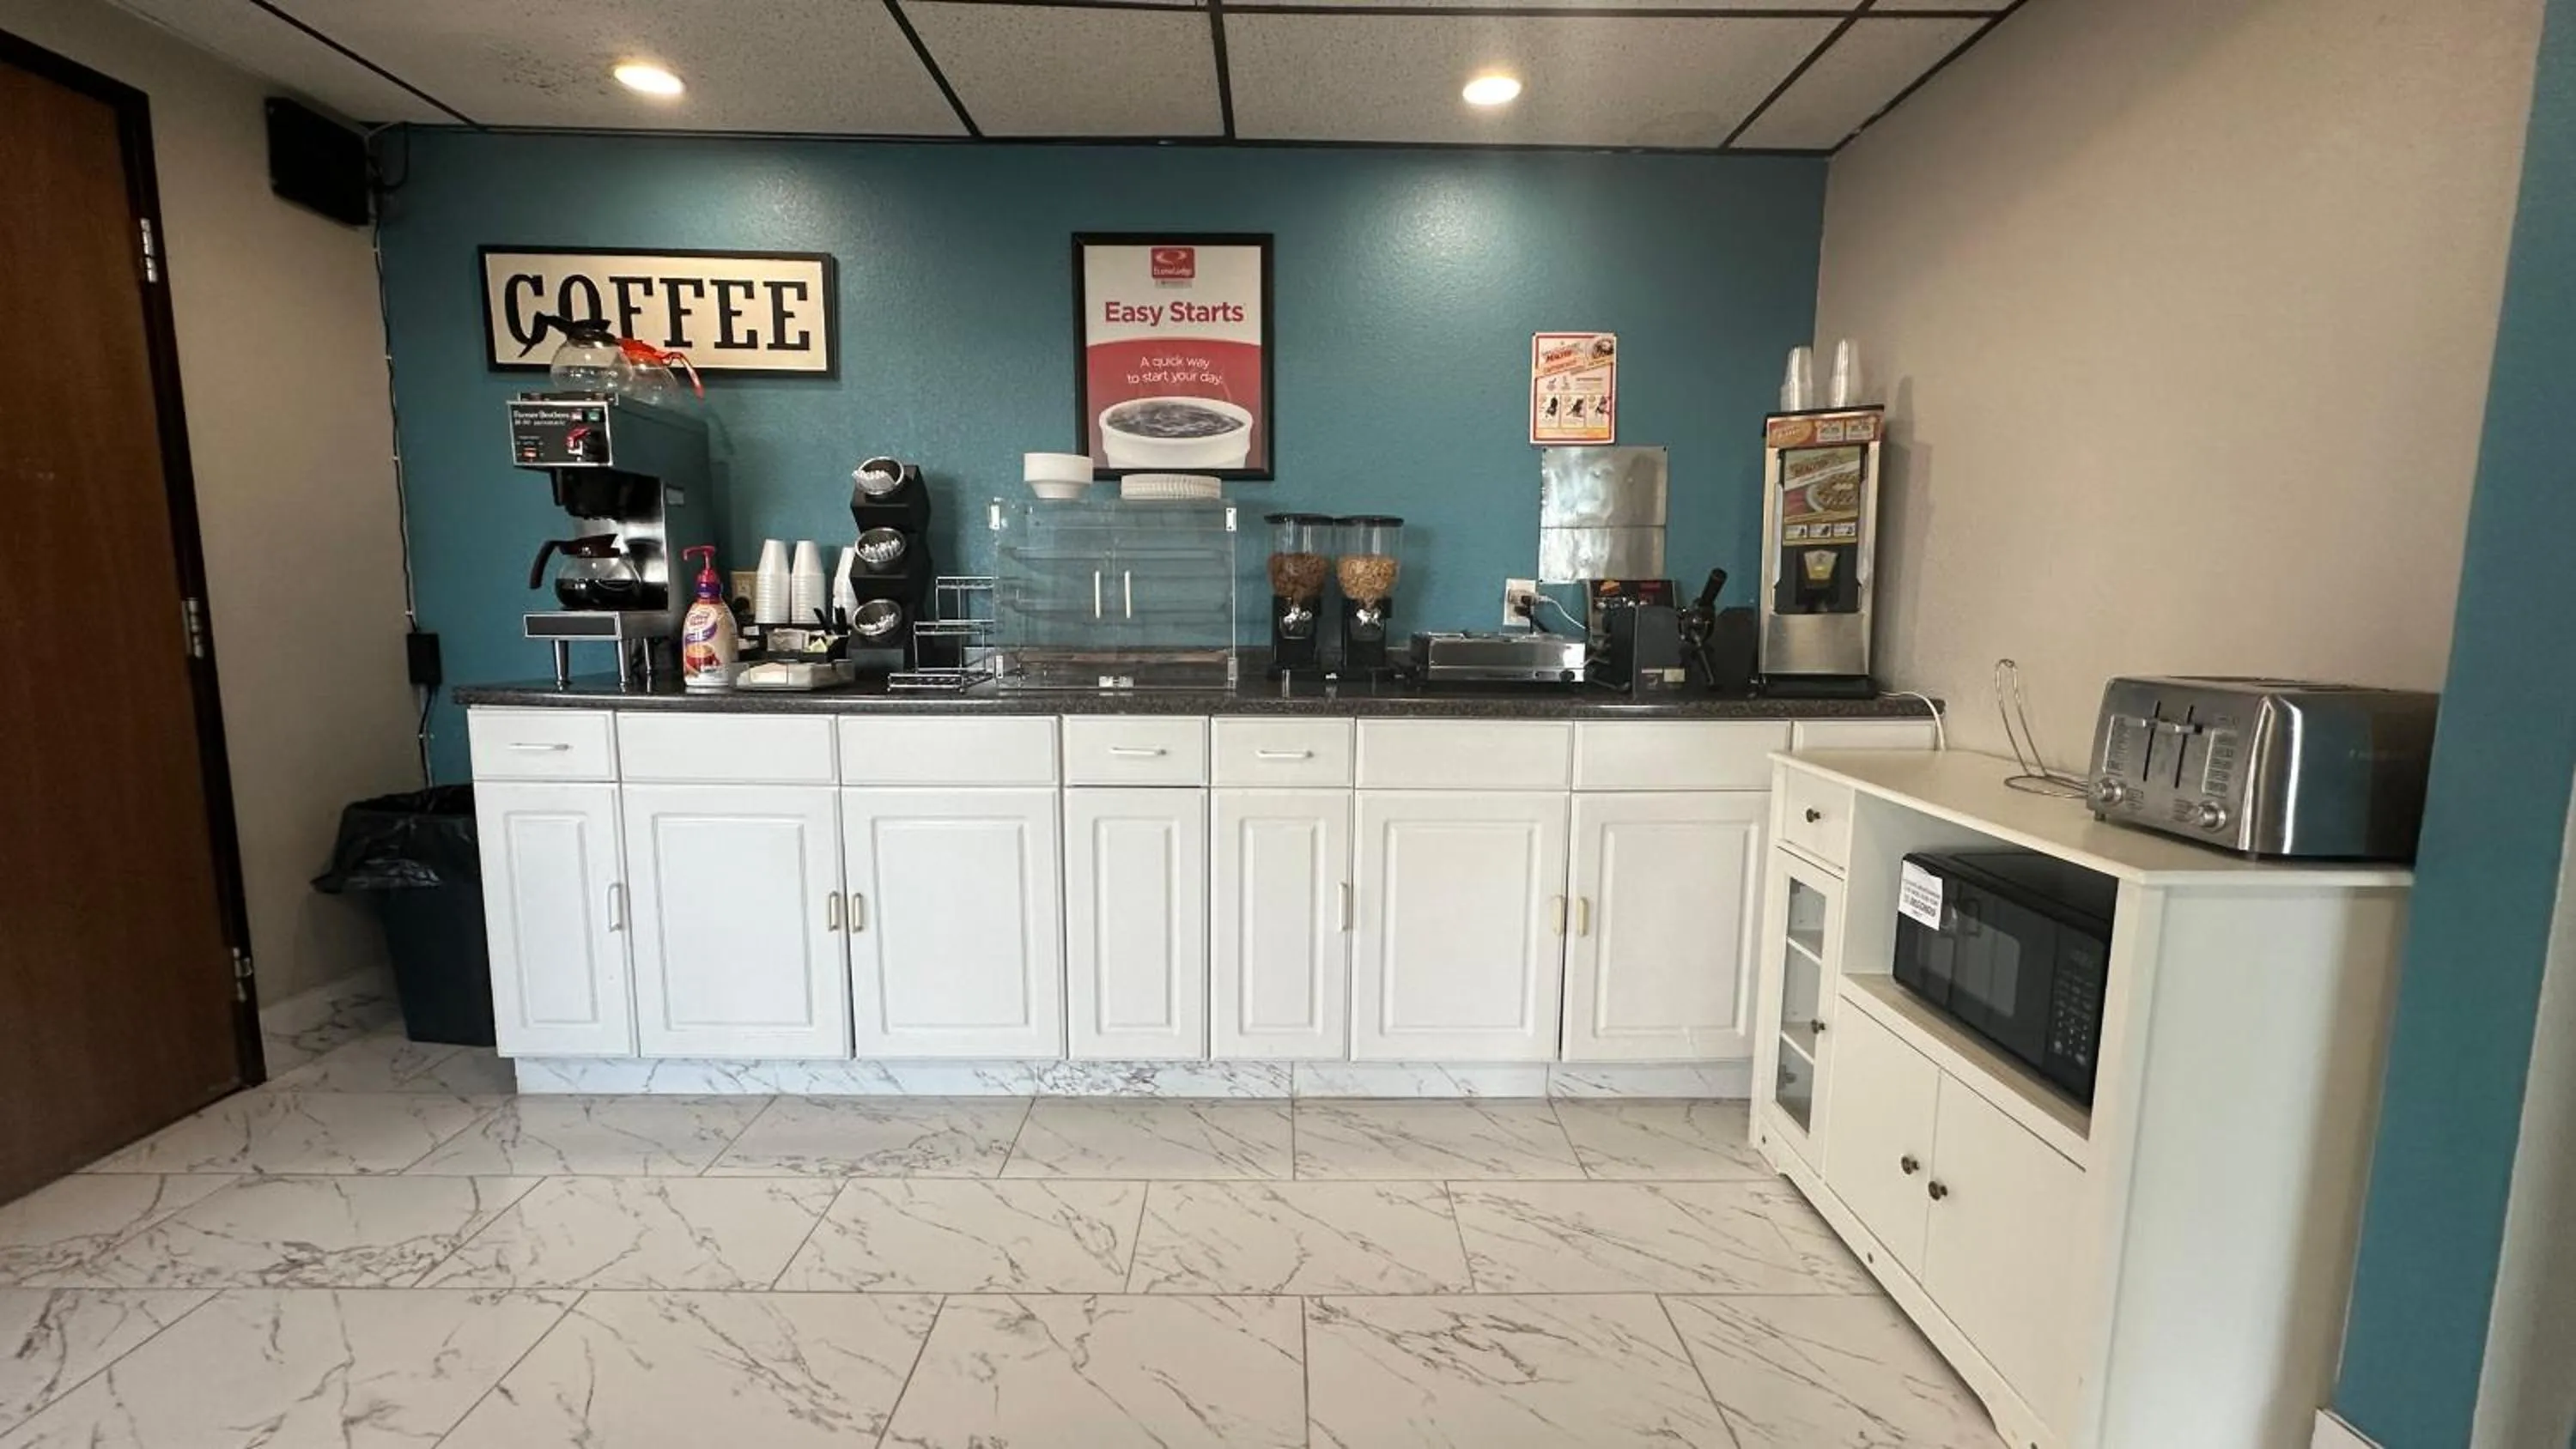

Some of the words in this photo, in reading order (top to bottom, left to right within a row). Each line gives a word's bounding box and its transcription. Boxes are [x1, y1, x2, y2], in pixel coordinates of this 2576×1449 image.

[504, 274, 811, 350] COFFEE
[1105, 301, 1163, 326] Easy
[1170, 301, 1244, 323] Starts
[1139, 356, 1150, 368] A
[1152, 355, 1183, 368] quick
[1186, 357, 1210, 369] way
[1127, 372, 1140, 384] to
[1142, 371, 1169, 382] start
[1170, 372, 1197, 383] your
